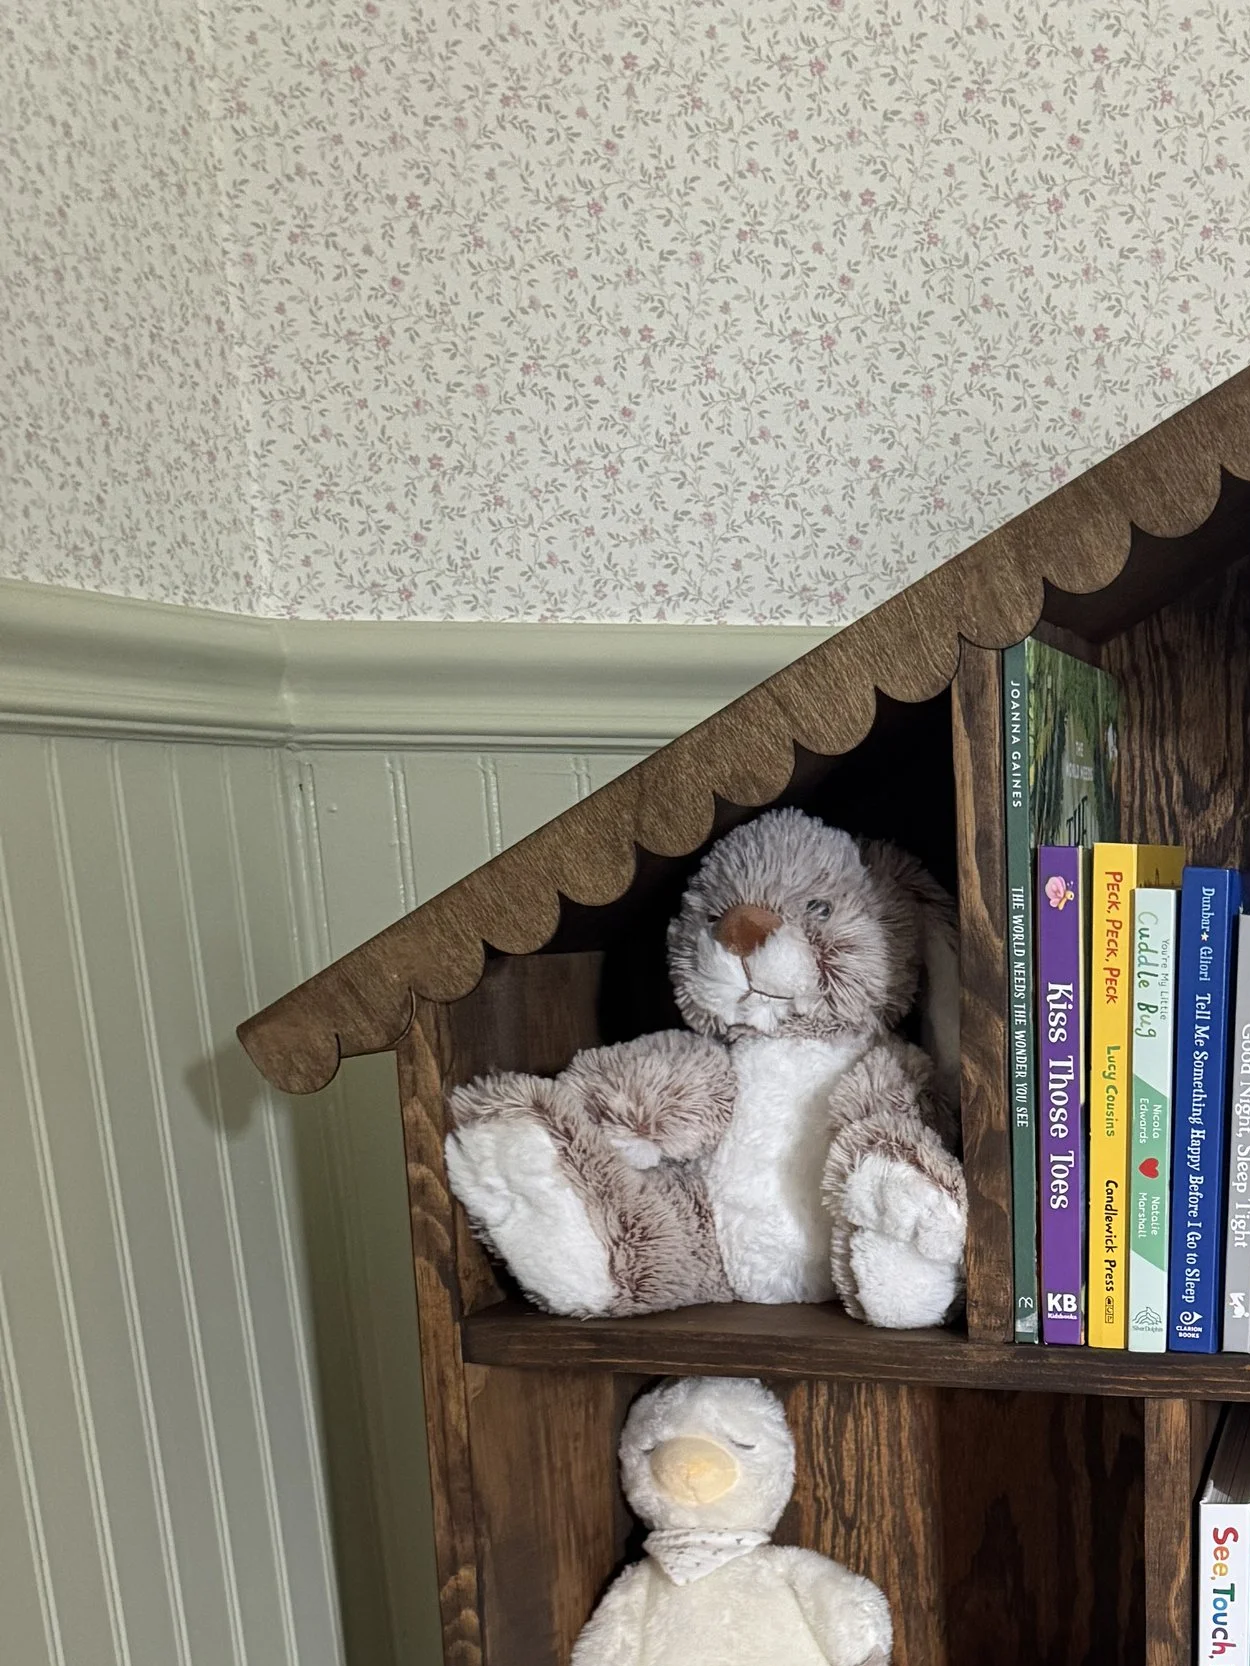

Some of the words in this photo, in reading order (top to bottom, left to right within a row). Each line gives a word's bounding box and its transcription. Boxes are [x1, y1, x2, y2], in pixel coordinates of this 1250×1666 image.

[1010, 680, 1021, 745] JOANNA
[1011, 751, 1022, 808] GAINES
[1011, 886, 1024, 910] THE
[1201, 886, 1216, 932] Dunbar
[1012, 914, 1026, 957] WORLD
[1137, 911, 1159, 988] Cuddle
[1160, 939, 1170, 969] You're
[1013, 961, 1026, 999] NEEDS
[1158, 973, 1170, 988] My
[1199, 945, 1213, 982] Gliori
[1014, 1003, 1026, 1026] THE
[1048, 982, 1074, 1043] Kiss
[1135, 1002, 1158, 1038] Bug
[1160, 992, 1170, 1020] Little
[1195, 993, 1211, 1020] Tell
[1014, 1030, 1028, 1078] WONDER
[1194, 1024, 1210, 1046] Me
[1102, 1046, 1120, 1080] Lucy
[1015, 1082, 1028, 1104] YOU
[1049, 1055, 1075, 1139] Those
[1188, 1050, 1208, 1125] Something
[1016, 1107, 1028, 1128] SEE
[1106, 1087, 1118, 1138] Cousins
[1140, 1098, 1150, 1144] Edwards
[1152, 1104, 1163, 1139] Nicola
[1188, 1128, 1206, 1172] Happy
[1050, 1150, 1075, 1209] Toes
[1188, 1175, 1204, 1218] Before
[1104, 1179, 1118, 1254] Candlewick
[1138, 1192, 1148, 1238] Marshall
[1150, 1196, 1162, 1236] Natalie
[1186, 1232, 1202, 1249] Go
[1186, 1252, 1198, 1265] to
[1104, 1259, 1117, 1292] Press
[1182, 1268, 1200, 1304] Sleep
[1047, 1293, 1078, 1312] KB
[1210, 1527, 1239, 1580] See,
[1208, 1583, 1236, 1659] Touch,
